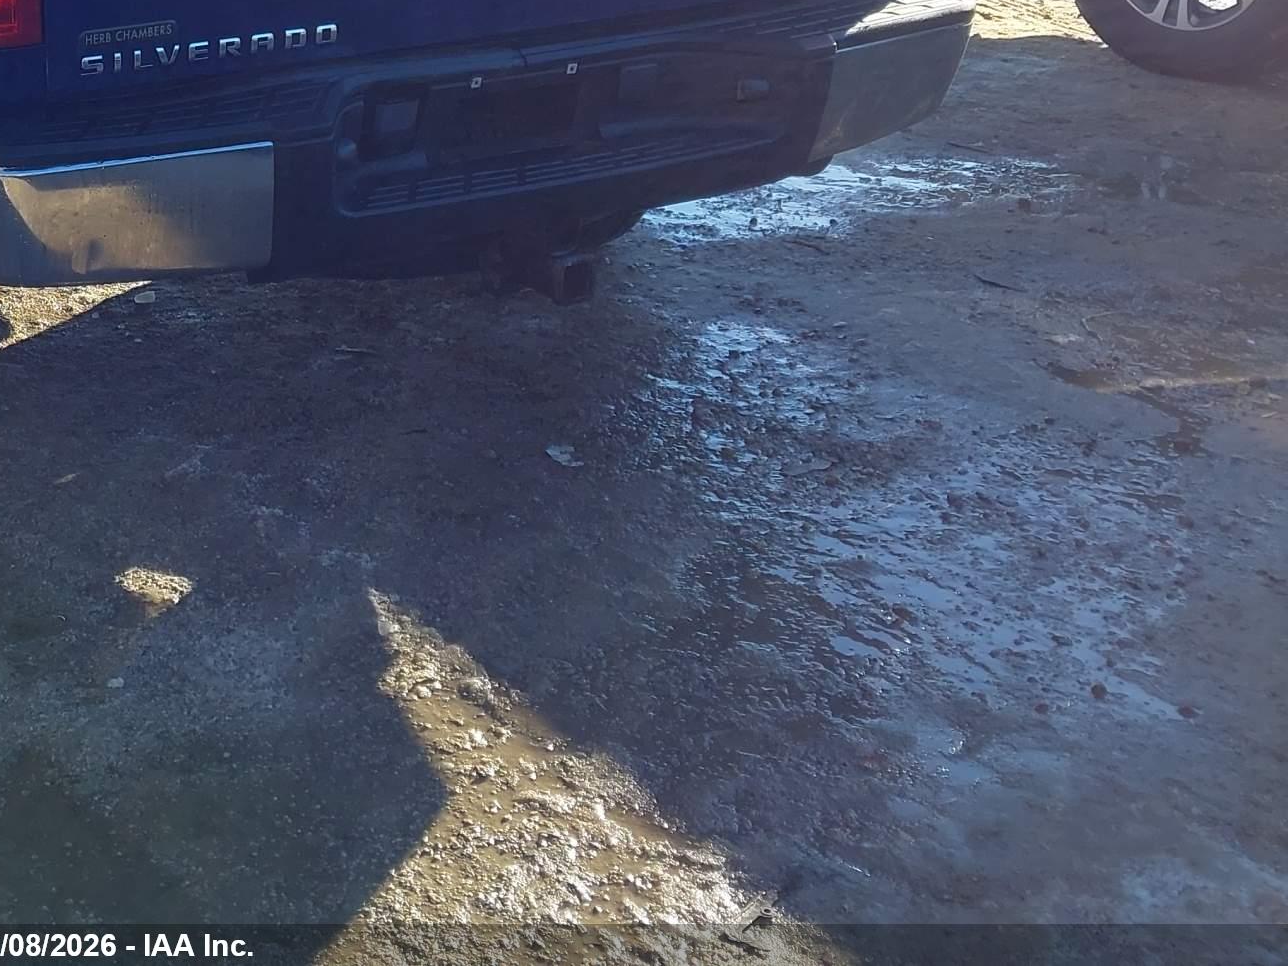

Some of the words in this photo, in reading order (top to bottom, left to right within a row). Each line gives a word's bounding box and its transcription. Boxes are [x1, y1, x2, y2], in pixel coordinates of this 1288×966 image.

[80, 23, 338, 76] SILVERADO
[85, 32, 111, 46] HERB
[115, 24, 173, 41] CHAMBERS
